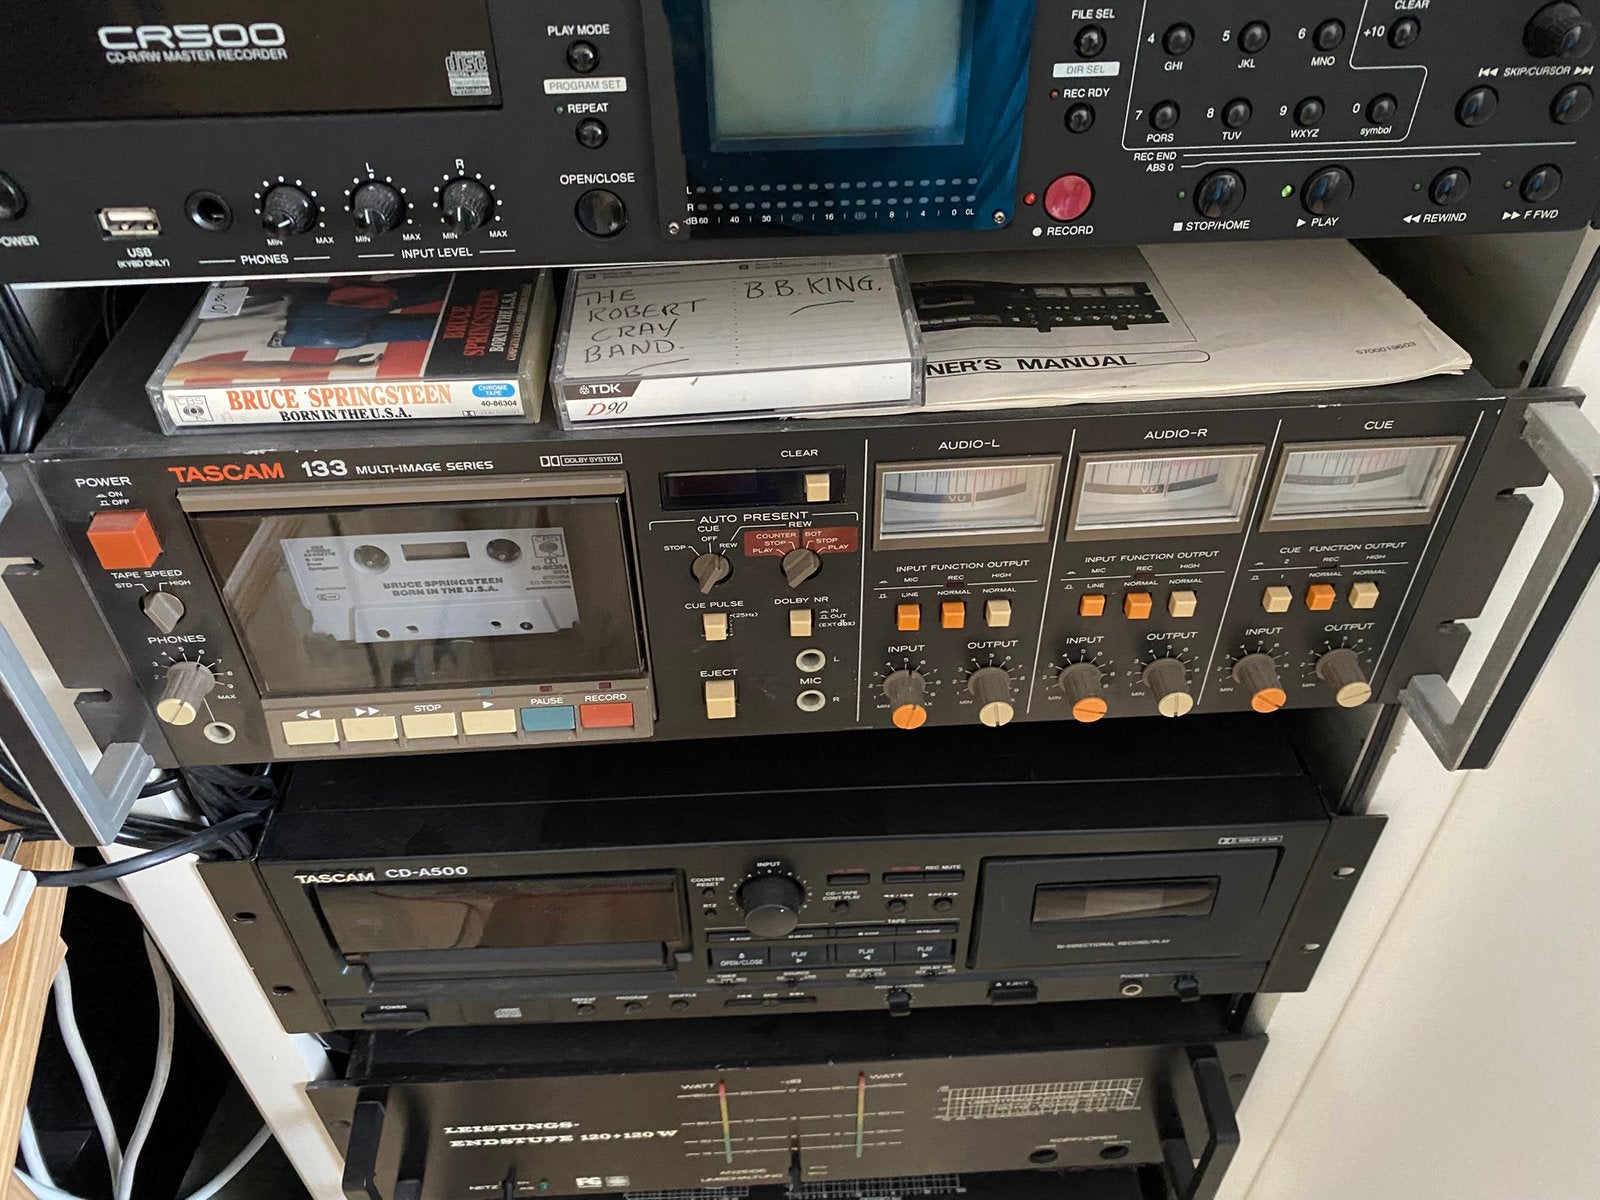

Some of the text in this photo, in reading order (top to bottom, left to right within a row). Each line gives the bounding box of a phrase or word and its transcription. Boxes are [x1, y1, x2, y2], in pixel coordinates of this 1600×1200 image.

[1072, 9, 1115, 20] FILE SEL
[547, 24, 610, 36] PLAY MODE
[1298, 28, 1306, 39] 6
[1363, 26, 1385, 37] +10
[99, 23, 285, 50] CR500
[1148, 33, 1155, 44] 4
[1222, 30, 1230, 42] 5
[106, 48, 288, 64] CD-R/RW MASTER RECORDER
[1311, 56, 1335, 67] MNO
[1066, 64, 1105, 75] DIR SEL
[1164, 61, 1183, 71] GHI
[1238, 59, 1256, 69] JKL
[1503, 66, 1571, 77] SKIP/CURSOR
[549, 79, 621, 91] PROGRAM SET
[1063, 87, 1110, 99] REC RDY
[567, 103, 609, 114] REPEAT
[1207, 108, 1214, 119] 8
[1280, 106, 1287, 117] 9
[1136, 110, 1142, 120] 7
[1222, 131, 1242, 141] TUV
[1290, 129, 1319, 139] WXYZ
[1360, 125, 1392, 137] symbol
[1146, 133, 1174, 144] PQRS
[1133, 151, 1177, 161] REC END
[1146, 163, 1165, 172] ABS
[559, 172, 635, 185] OPEN/CLOSE
[1423, 212, 1467, 224] REWIND
[1523, 210, 1559, 220] F FWD
[1186, 220, 1250, 232] STOP/HOME
[1311, 216, 1339, 227] PLAY
[489, 230, 508, 240] MAX
[1047, 225, 1093, 237] RECORD
[0, 235, 39, 247] OWER
[315, 236, 335, 245] MAX
[402, 233, 421, 242] MAX
[127, 247, 152, 258] USB
[401, 247, 473, 260] INPUT LEVEL
[240, 254, 289, 265] PHONES
[586, 289, 636, 306] THE
[591, 318, 678, 343] CRAY
[926, 355, 1137, 376] NER'S MANUAL
[589, 383, 622, 394] TDK
[226, 384, 451, 410] BRUCE SPRINGSTEEN
[279, 407, 412, 421] BORN IN THE U.S.A.
[586, 401, 628, 416] D90
[1364, 419, 1395, 431] CUE
[1143, 428, 1208, 440] AUDIO-R
[938, 440, 1000, 451] AUDIO-L
[780, 449, 818, 458] CLEAR
[564, 455, 619, 465] DOLBY SYSTEM
[168, 460, 494, 483] TASCAM 133 MULTI-IMAGE SERIES
[75, 476, 132, 488] POWER
[699, 511, 809, 524] AUTO PRESENT
[697, 525, 720, 533] CUE
[788, 520, 812, 528] REW
[756, 532, 797, 540] COUNTER
[1309, 544, 1362, 553] FUNCTION
[1365, 541, 1407, 550] OUTPUT
[1085, 550, 1220, 563] INPUT FUNCTION OUTPUT
[896, 559, 1030, 573] INPUT FUNCTION OUTPUT
[111, 569, 183, 580] TAPE SPEED
[383, 577, 504, 590] BRUCE SPRINGSTEEN
[392, 588, 426, 597] BORN
[441, 587, 463, 595] THE
[684, 600, 744, 610] CUE PULSE
[774, 595, 829, 605] DOLBY NR
[1245, 627, 1283, 636] INPUT
[1324, 622, 1375, 632] OUTPUT
[148, 635, 206, 645] PHONES
[1066, 636, 1104, 645] INPUT
[1146, 632, 1198, 641] OUTPUT
[888, 644, 925, 653] INPUT
[967, 640, 1019, 650] OUTPUT
[700, 669, 738, 678] EJECT
[800, 677, 822, 685] MIC
[530, 697, 564, 706] PAUSE
[584, 693, 627, 703] RECORD
[414, 704, 442, 713] STOP
[294, 866, 468, 884] TASCAM CD-A500
[444, 1121, 580, 1134] LEISTUNGS-
[450, 1134, 574, 1147] ENDSTUFE
[580, 1131, 655, 1142] 120+120
